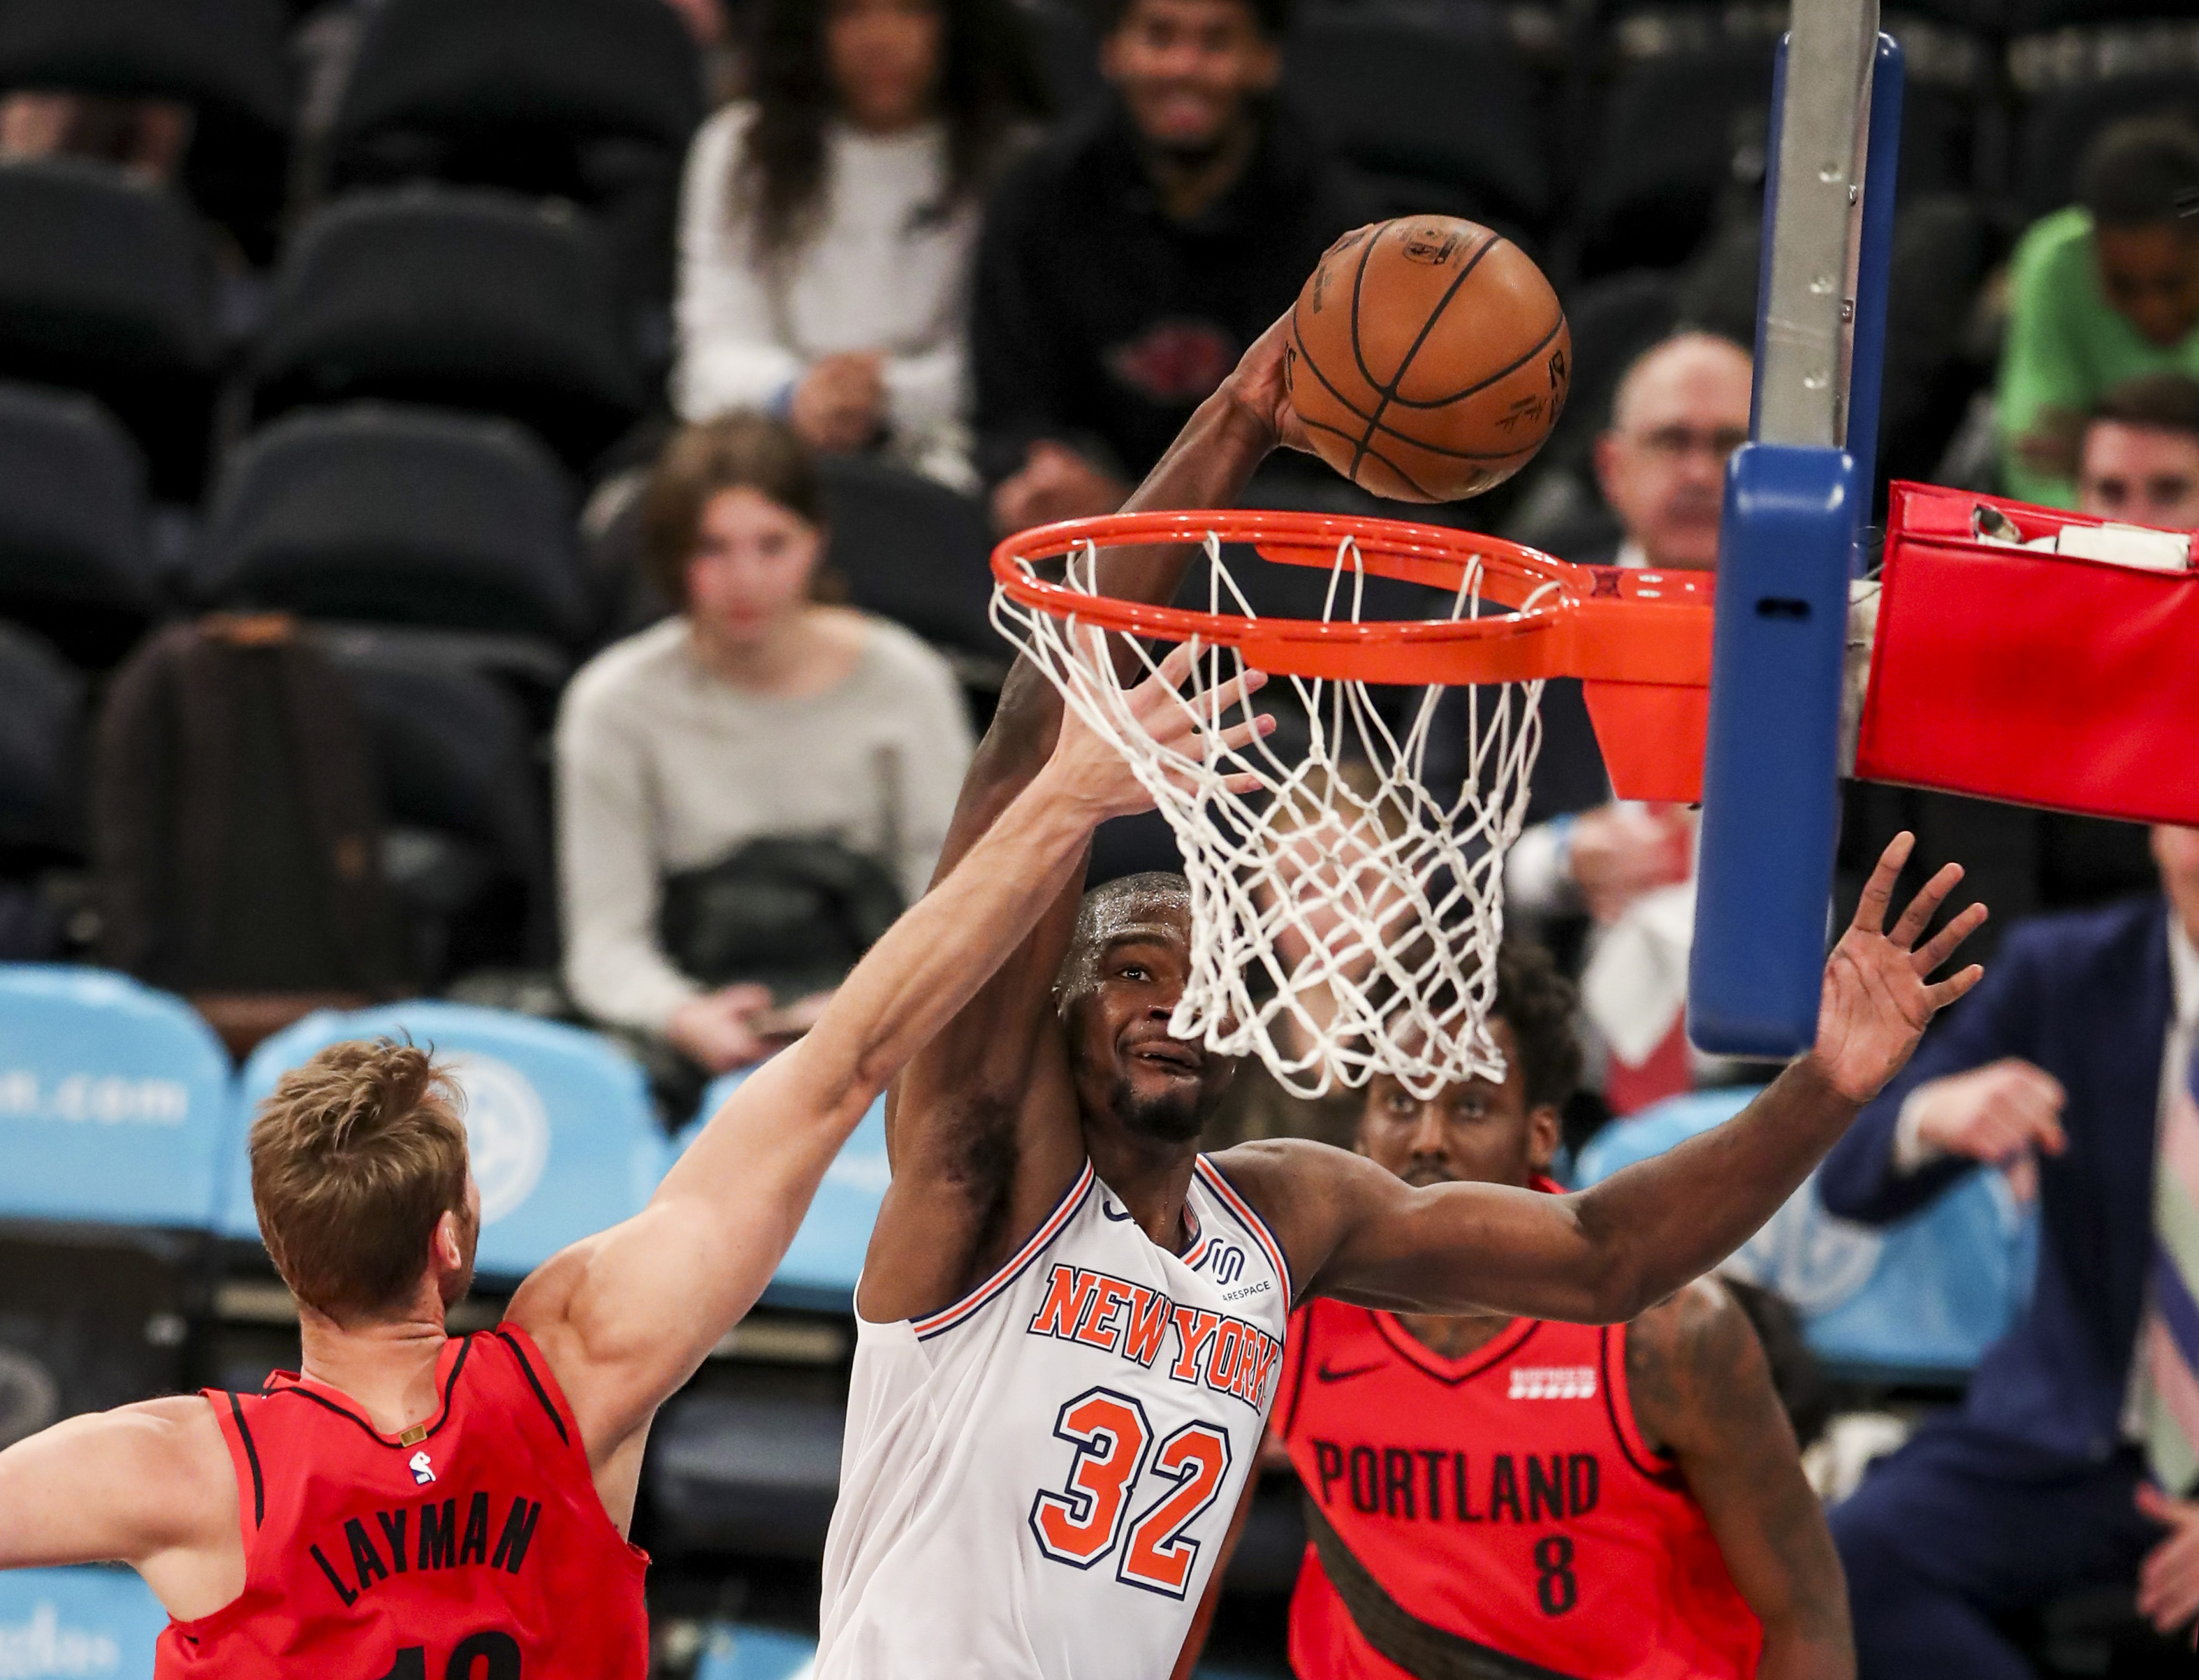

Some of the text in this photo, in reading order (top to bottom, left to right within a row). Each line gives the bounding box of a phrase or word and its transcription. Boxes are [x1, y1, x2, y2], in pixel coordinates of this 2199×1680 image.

[1027, 1263, 1283, 1417] NEW YORK
[1222, 1281, 1271, 1302] ARESPACE
[1028, 1386, 1232, 1601] 32
[1311, 1438, 1600, 1524] PORTLAND
[310, 1492, 541, 1607] LAYMAN
[1534, 1535, 1577, 1618] 8
